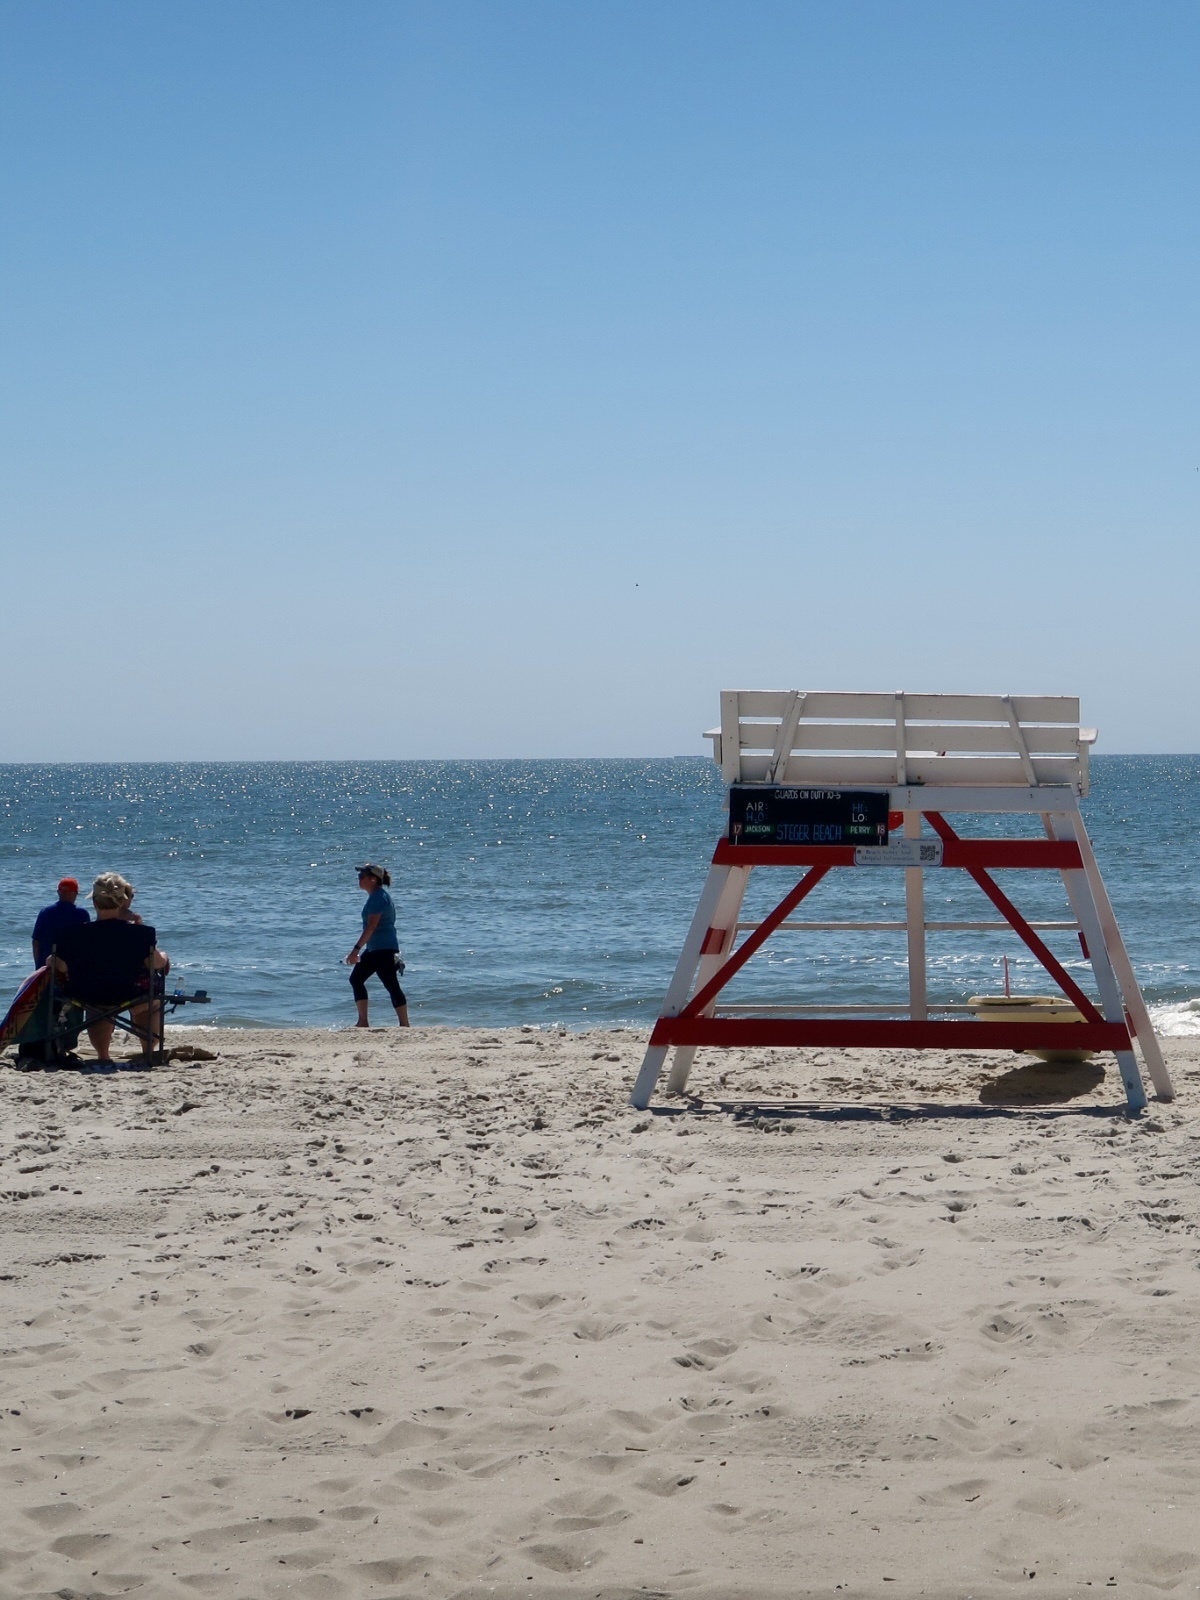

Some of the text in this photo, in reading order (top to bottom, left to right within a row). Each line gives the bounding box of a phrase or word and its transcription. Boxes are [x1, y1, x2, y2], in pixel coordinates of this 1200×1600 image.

[774, 790, 798, 799] GUARDS
[800, 790, 810, 799] ON
[810, 790, 824, 799] DUTY
[734, 824, 742, 834] 17
[744, 825, 770, 833] JACKSON
[776, 824, 842, 841] STEGER BEACH
[850, 826, 871, 834] PERRY
[877, 824, 885, 834] 18
